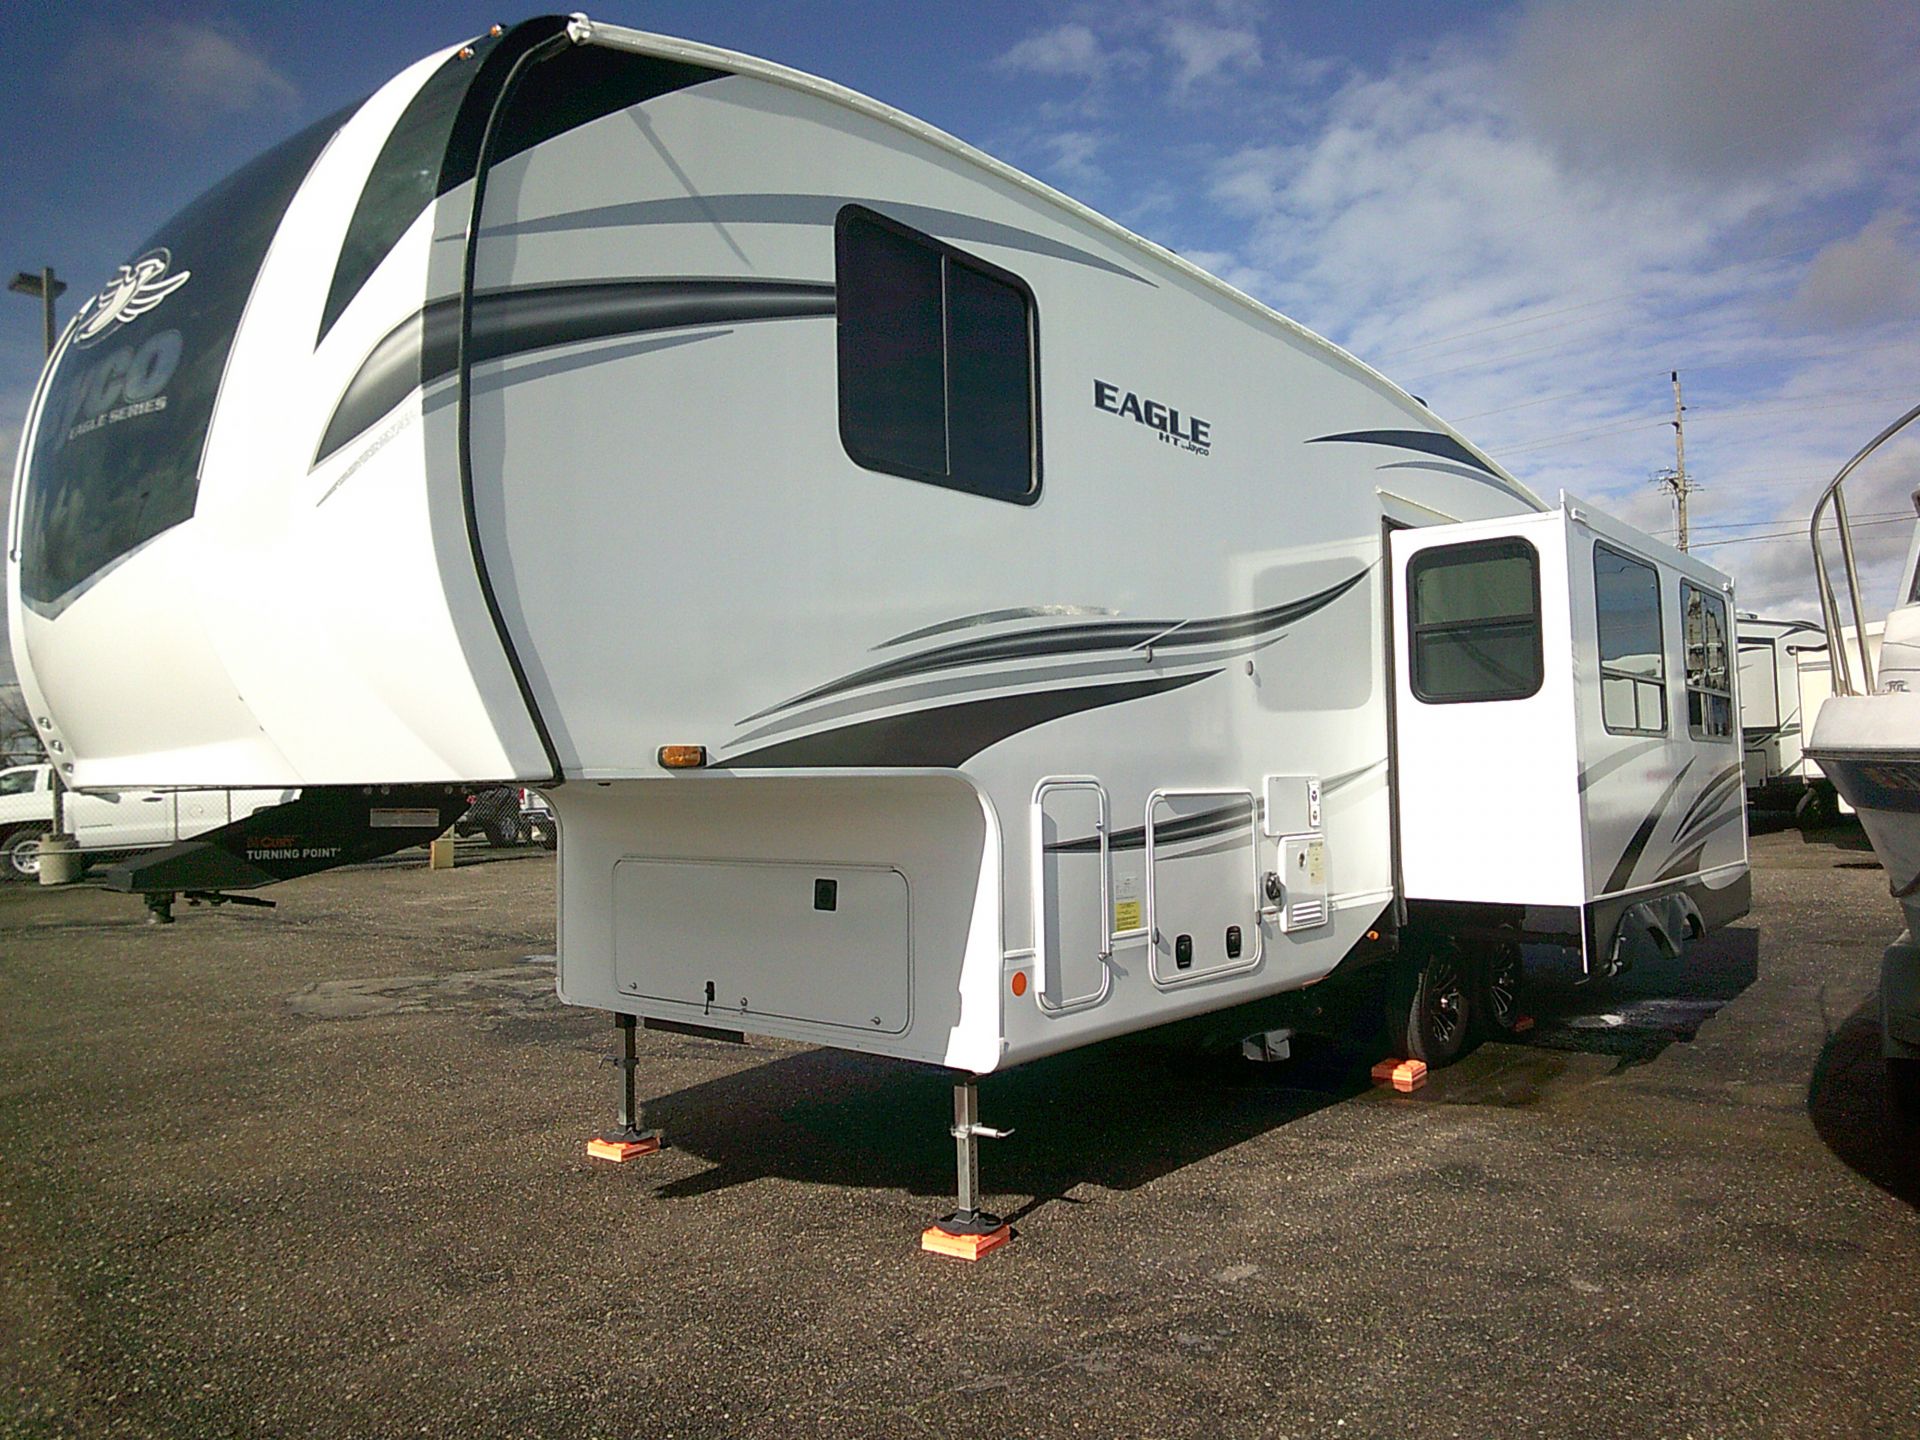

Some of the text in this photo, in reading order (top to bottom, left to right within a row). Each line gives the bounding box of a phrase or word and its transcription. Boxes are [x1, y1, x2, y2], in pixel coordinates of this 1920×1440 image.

[108, 395, 169, 424] SERIES
[1093, 379, 1212, 448] EAGLE
[1186, 441, 1210, 456] Jayco
[246, 847, 338, 861] TURNING POINT
